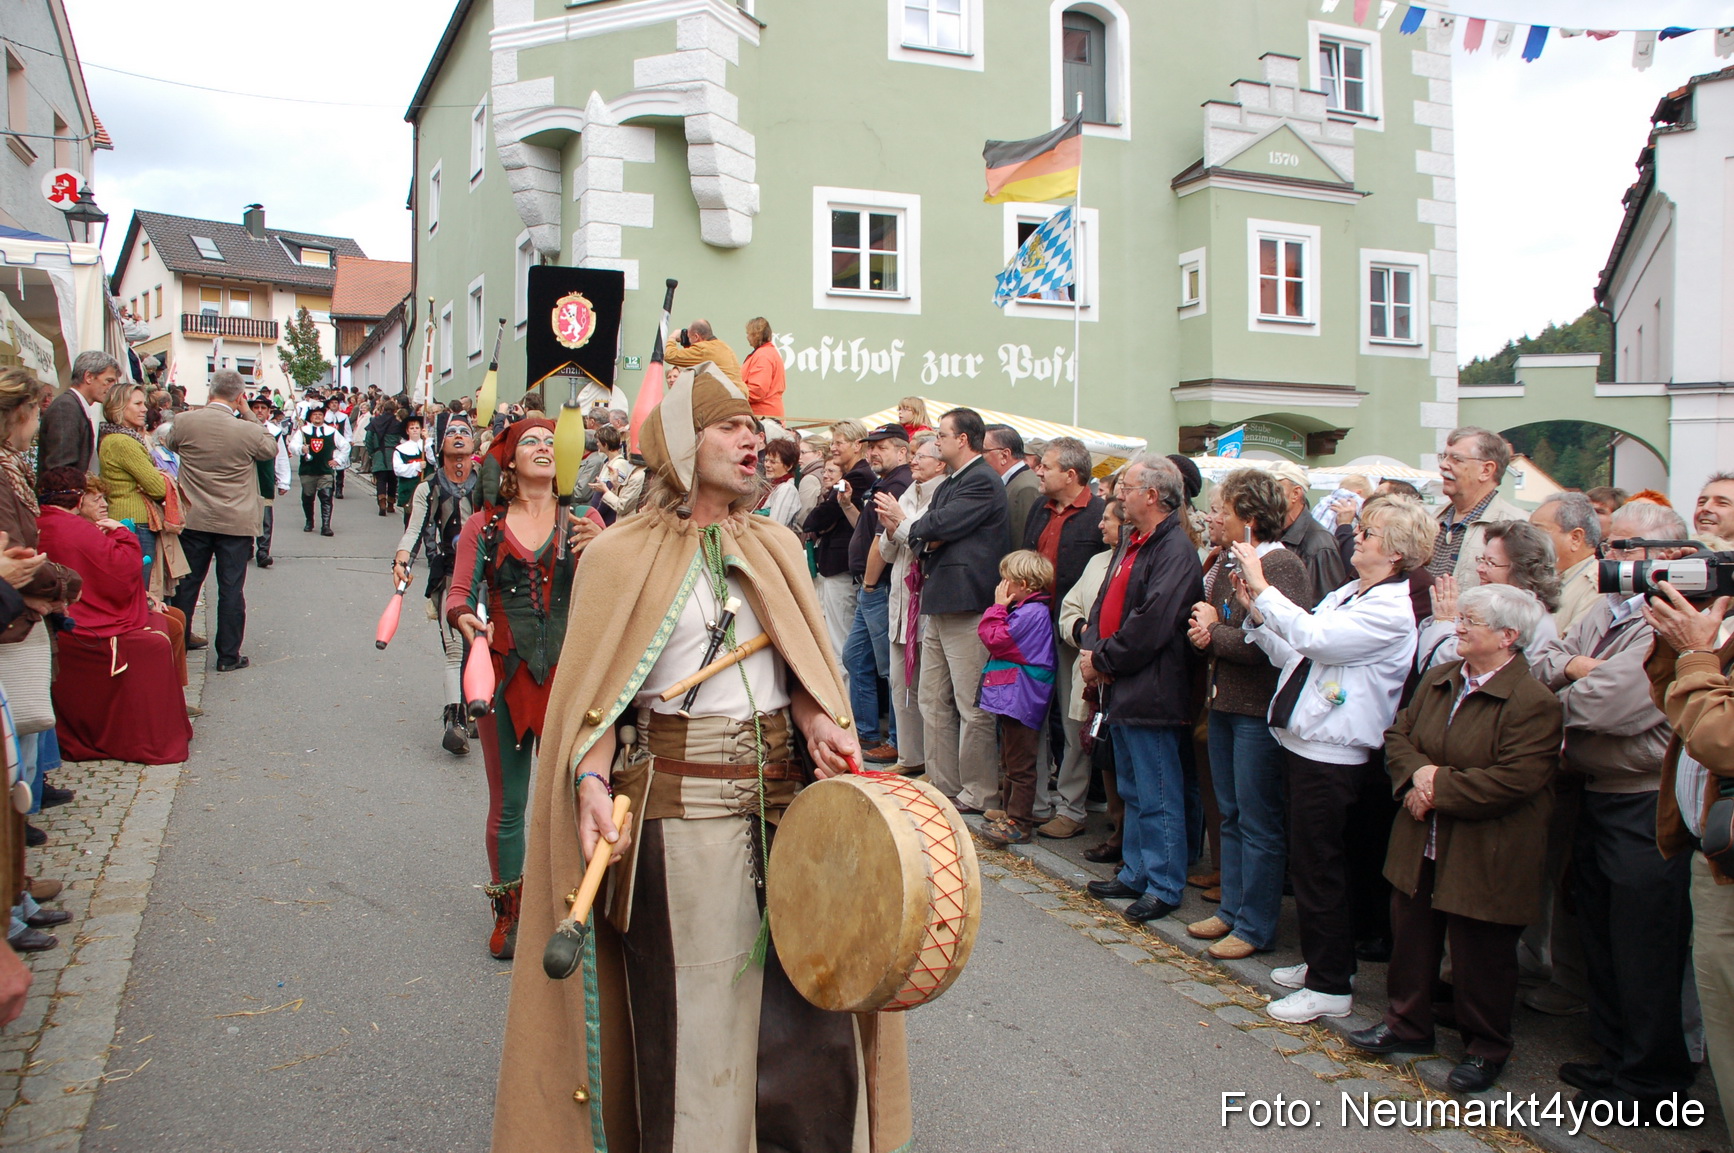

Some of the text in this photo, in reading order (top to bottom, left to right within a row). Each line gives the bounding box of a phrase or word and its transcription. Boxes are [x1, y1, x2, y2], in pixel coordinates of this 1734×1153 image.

[1268, 149, 1299, 167] 1570
[772, 332, 1076, 388] Gasthof zur Post
